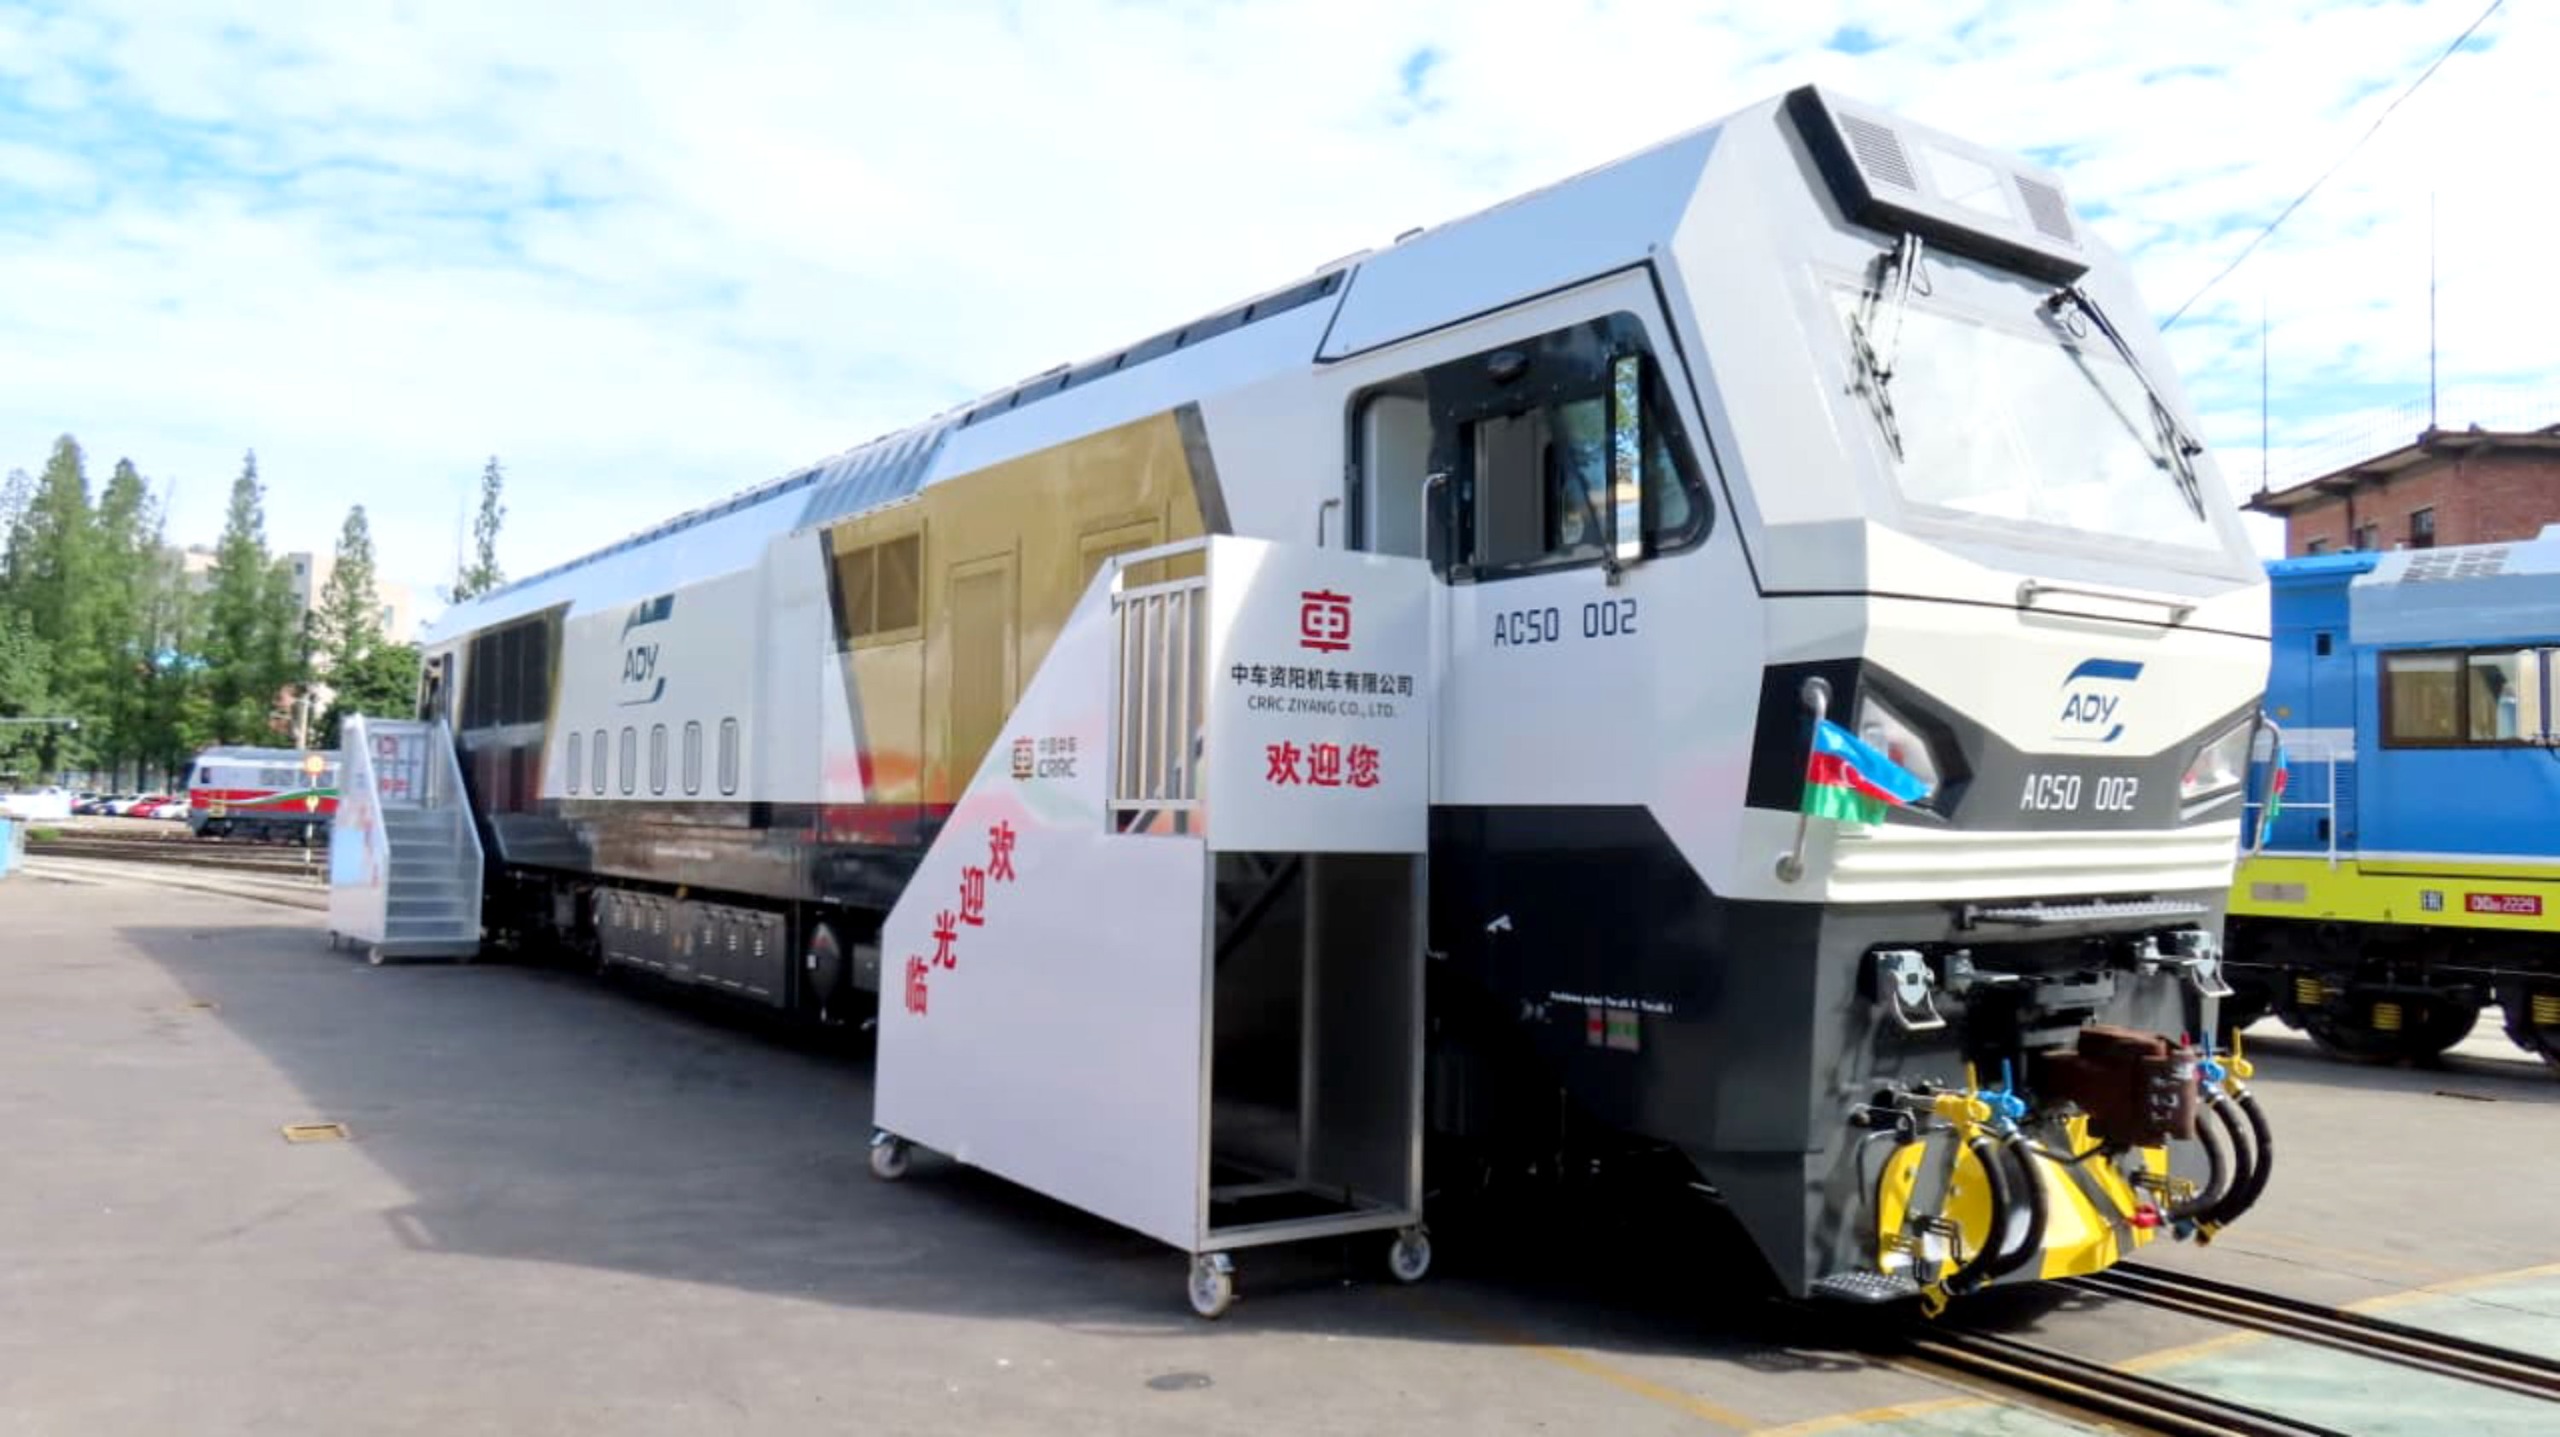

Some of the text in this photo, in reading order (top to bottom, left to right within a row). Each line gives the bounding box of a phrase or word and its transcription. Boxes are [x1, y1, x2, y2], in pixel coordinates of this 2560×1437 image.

[1583, 598, 1637, 638] 002
[623, 644, 659, 682] ADY
[1231, 662, 1413, 697] 中车资阳机车有限公司
[1247, 694, 1285, 713] CRRC
[1287, 697, 1336, 715] ZIYANG
[1369, 703, 1398, 719] LTD.
[2061, 692, 2119, 724] ADY
[1266, 741, 1380, 788] 欢迎您
[2095, 776, 2138, 811] 002
[905, 820, 1016, 1016] 欢迎光临
